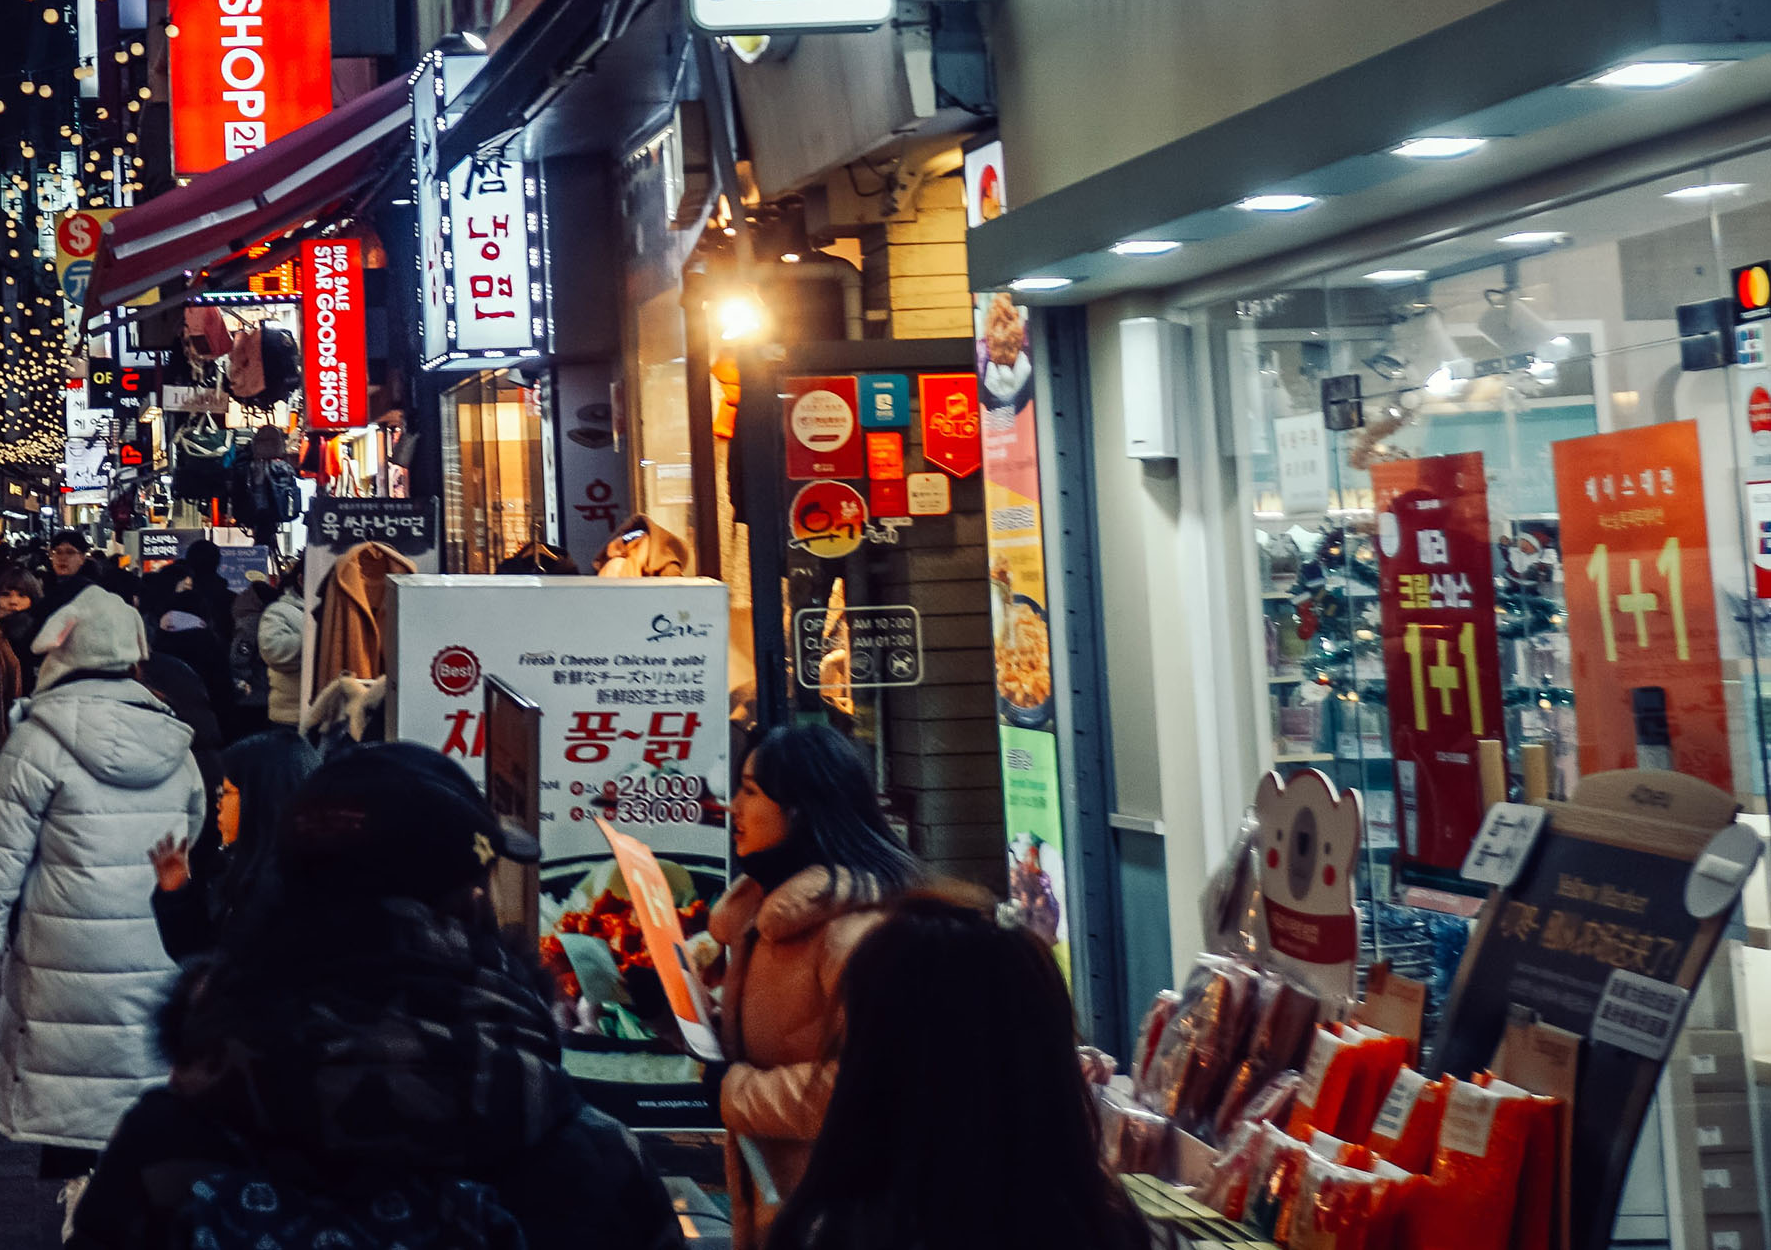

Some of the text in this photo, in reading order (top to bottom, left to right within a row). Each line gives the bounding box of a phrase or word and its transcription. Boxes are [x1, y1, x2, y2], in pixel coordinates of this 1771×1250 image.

[332, 245, 350, 311] BIG SALE
[314, 245, 340, 423] STAR GOODS SHOP
[1586, 537, 1691, 662] 1+1
[440, 663, 473, 678] Best
[560, 654, 609, 667] Cheese
[613, 654, 667, 667] Chicken
[1403, 622, 1485, 735] 1+1
[617, 775, 701, 799] 24,000
[617, 800, 701, 825] 33,000
